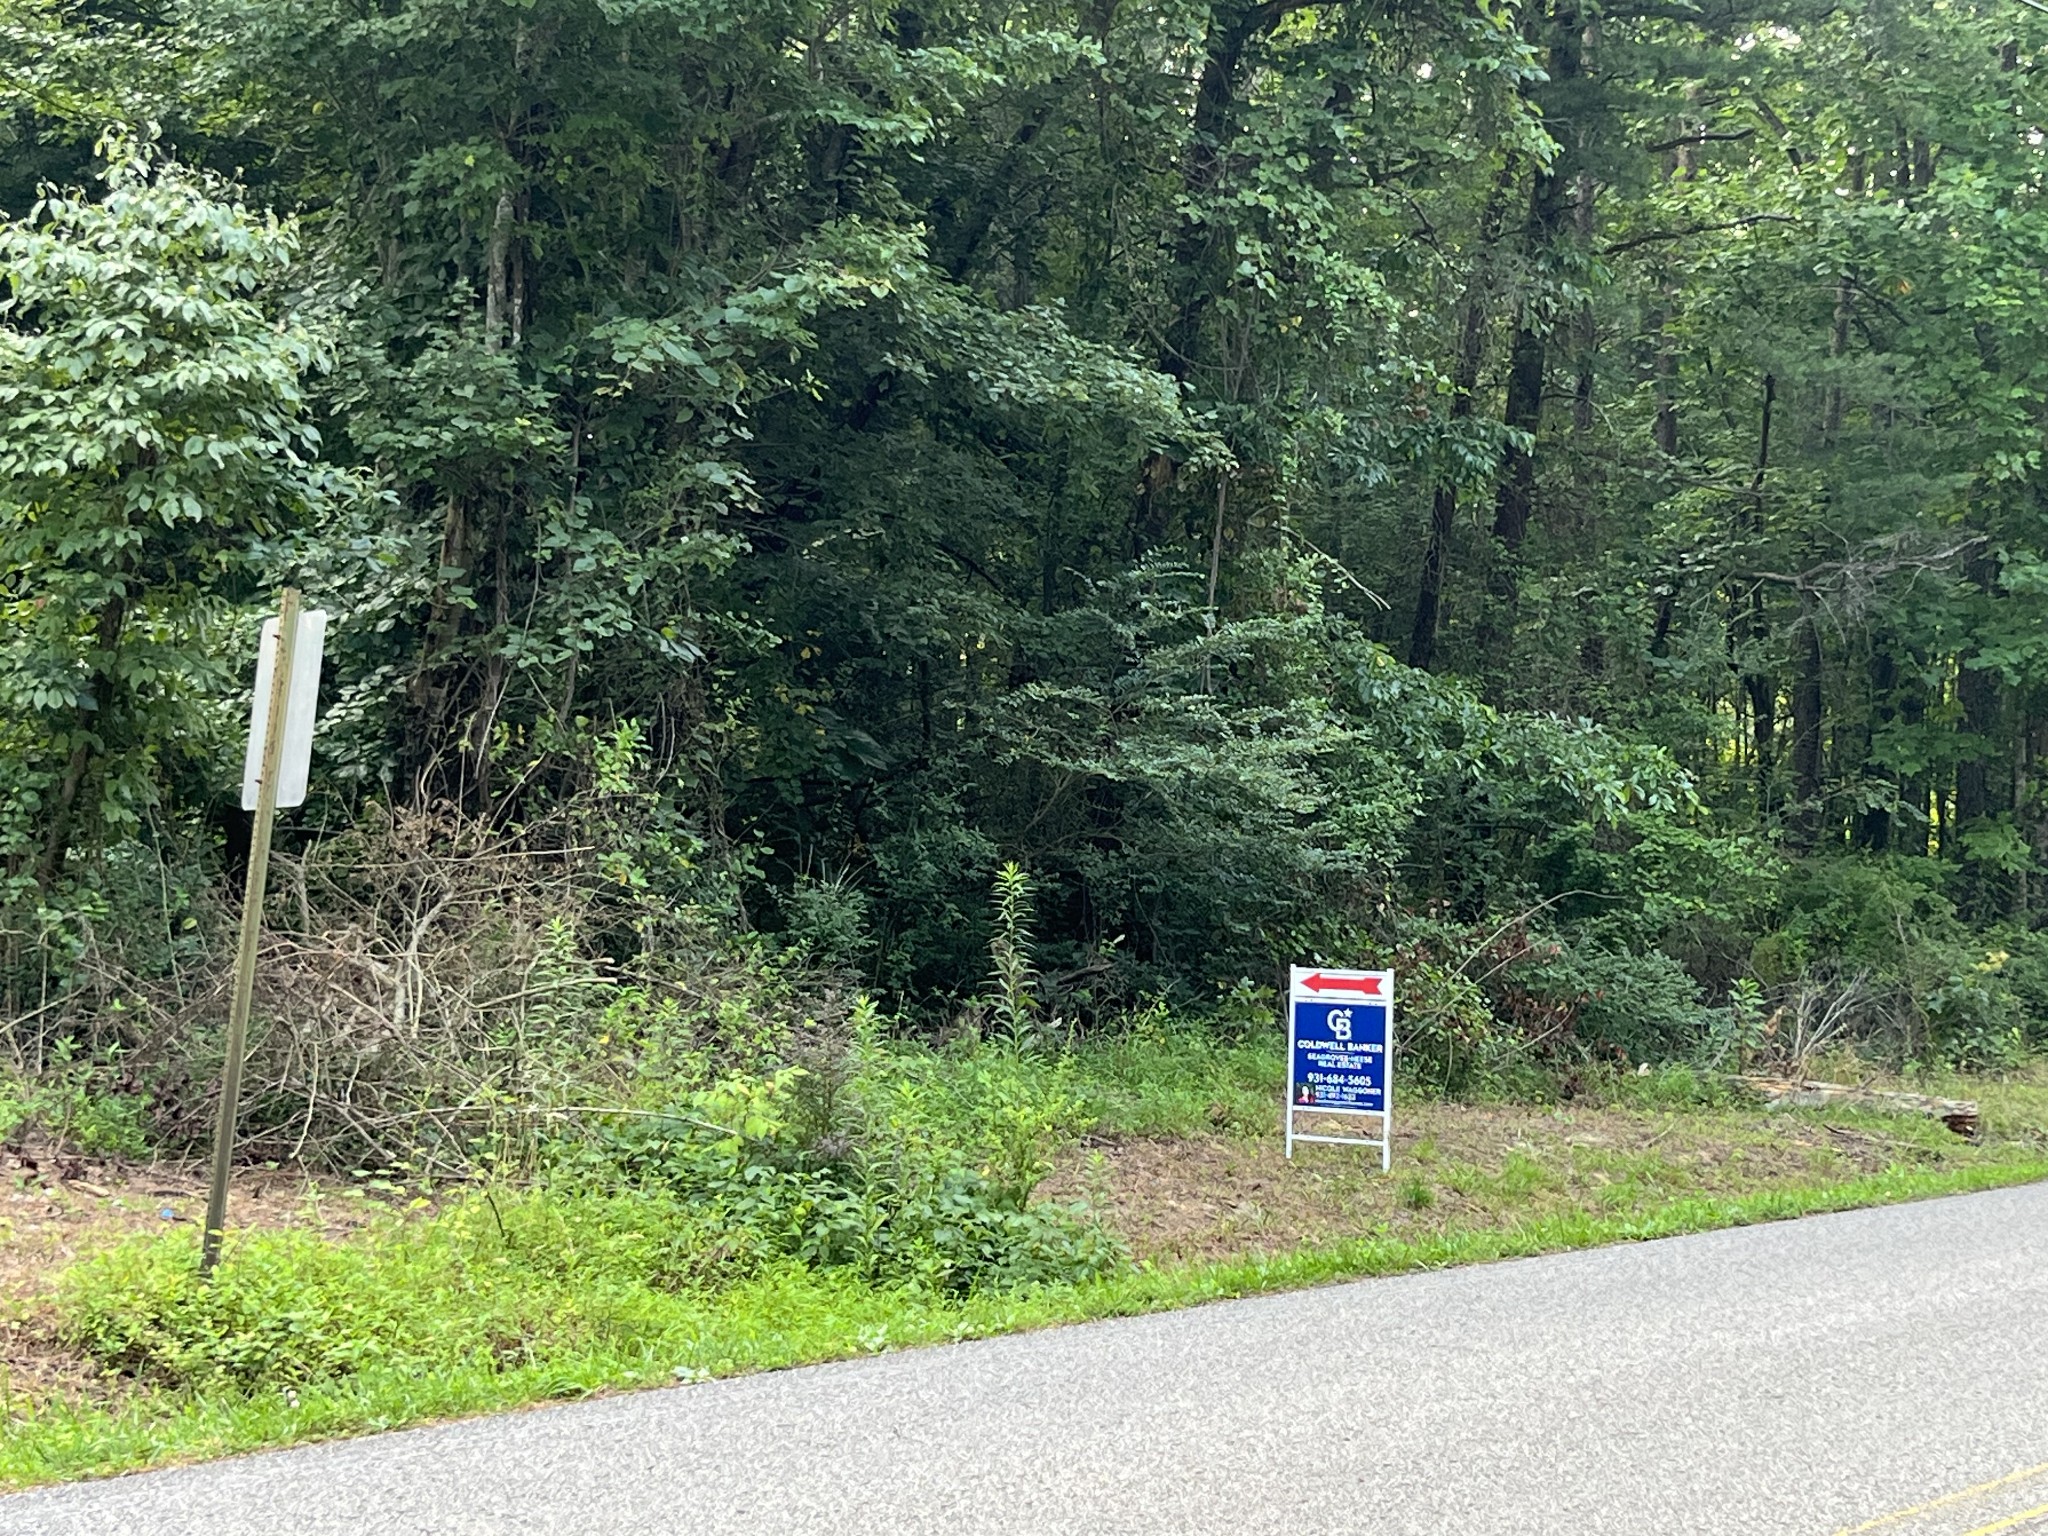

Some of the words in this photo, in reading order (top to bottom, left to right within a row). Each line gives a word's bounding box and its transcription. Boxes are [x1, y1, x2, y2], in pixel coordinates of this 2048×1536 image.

[1297, 1039, 1346, 1051] COLDWELL
[1347, 1043, 1383, 1053] BANKER
[1318, 1060, 1336, 1068] REAL
[1337, 1062, 1362, 1070] ESTATE
[1307, 1072, 1372, 1087] 931-684-5605
[1315, 1084, 1340, 1093] NICOLE
